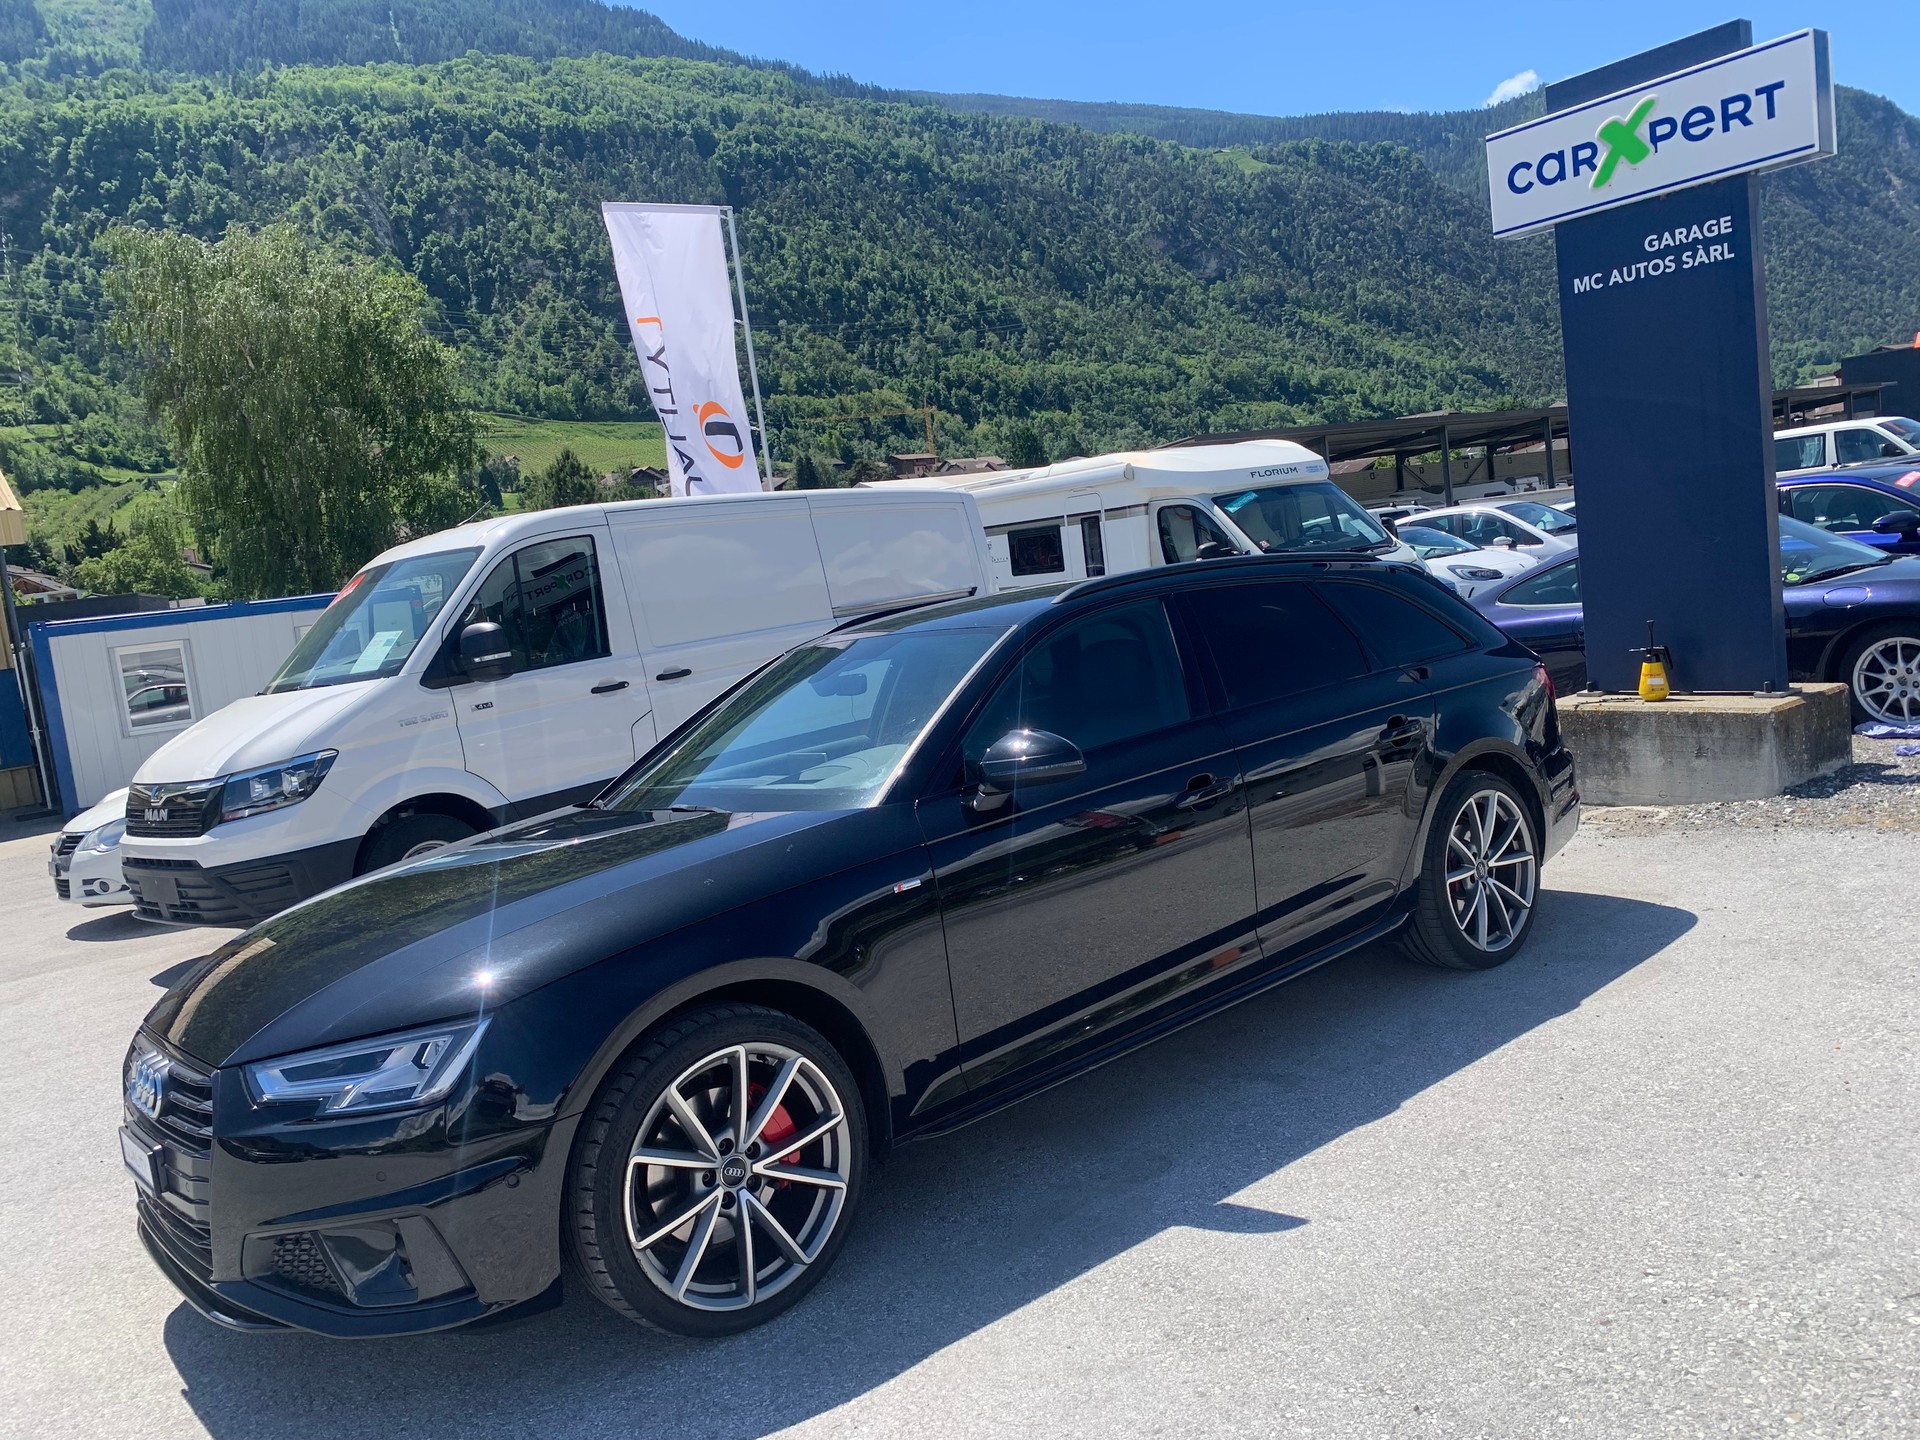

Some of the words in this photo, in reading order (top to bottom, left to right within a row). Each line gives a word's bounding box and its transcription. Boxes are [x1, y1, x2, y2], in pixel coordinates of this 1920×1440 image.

[1644, 215, 1733, 252] GARAGE
[1573, 273, 1604, 294] MC
[1608, 255, 1676, 286] AUTOS
[1682, 243, 1735, 269] SÀRL
[1250, 466, 1299, 478] FLORIUM
[144, 808, 168, 821] MAN
